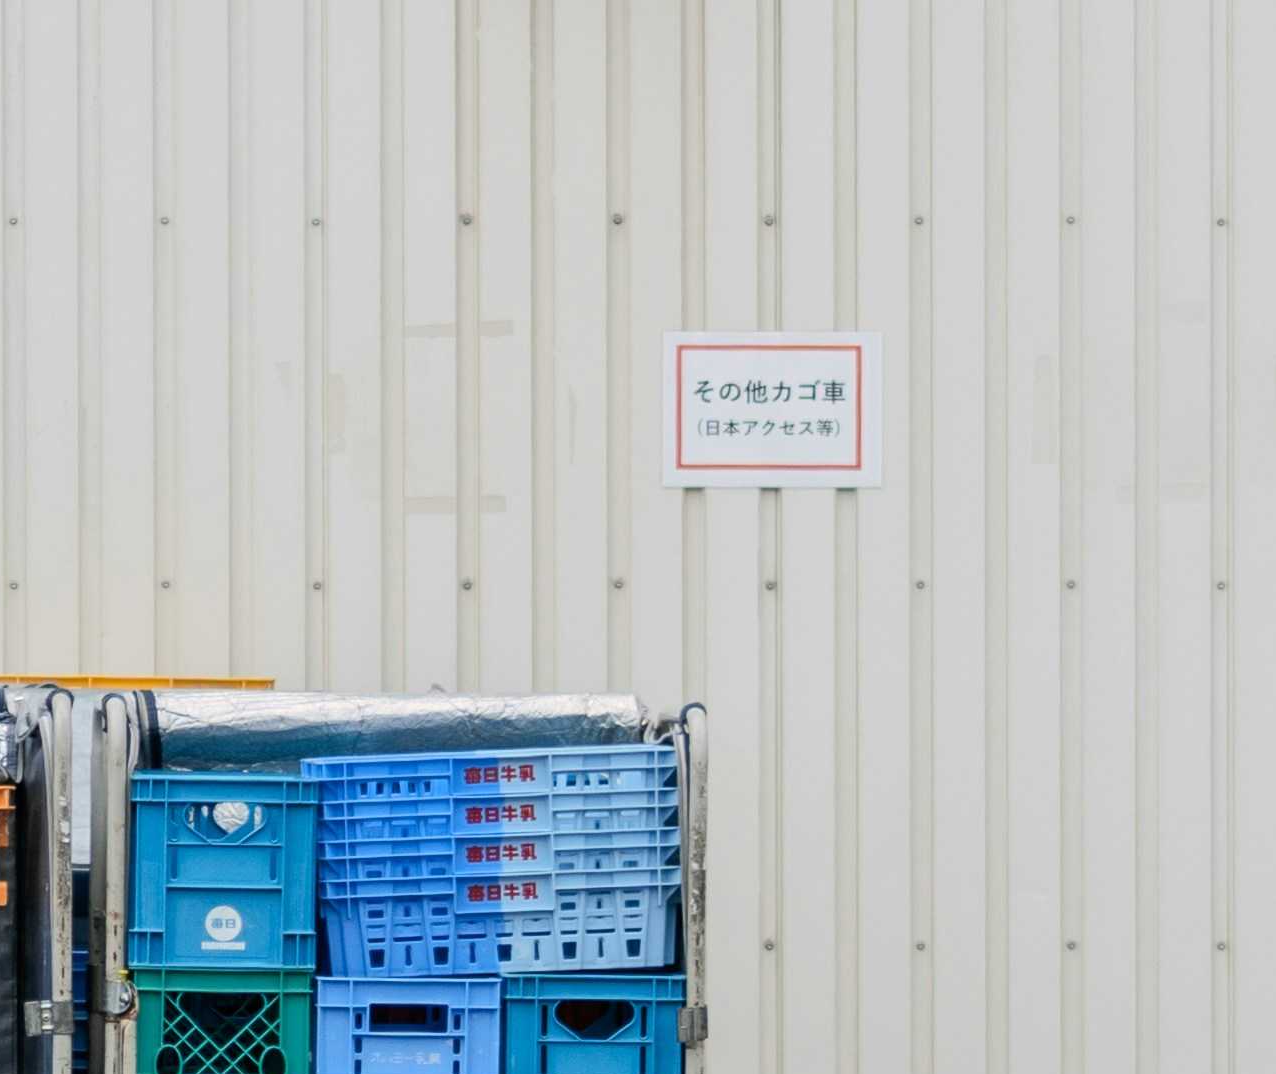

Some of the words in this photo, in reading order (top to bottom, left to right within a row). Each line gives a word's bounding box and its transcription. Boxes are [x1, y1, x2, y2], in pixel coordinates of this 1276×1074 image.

[694, 380, 845, 404] その他カゴ車
